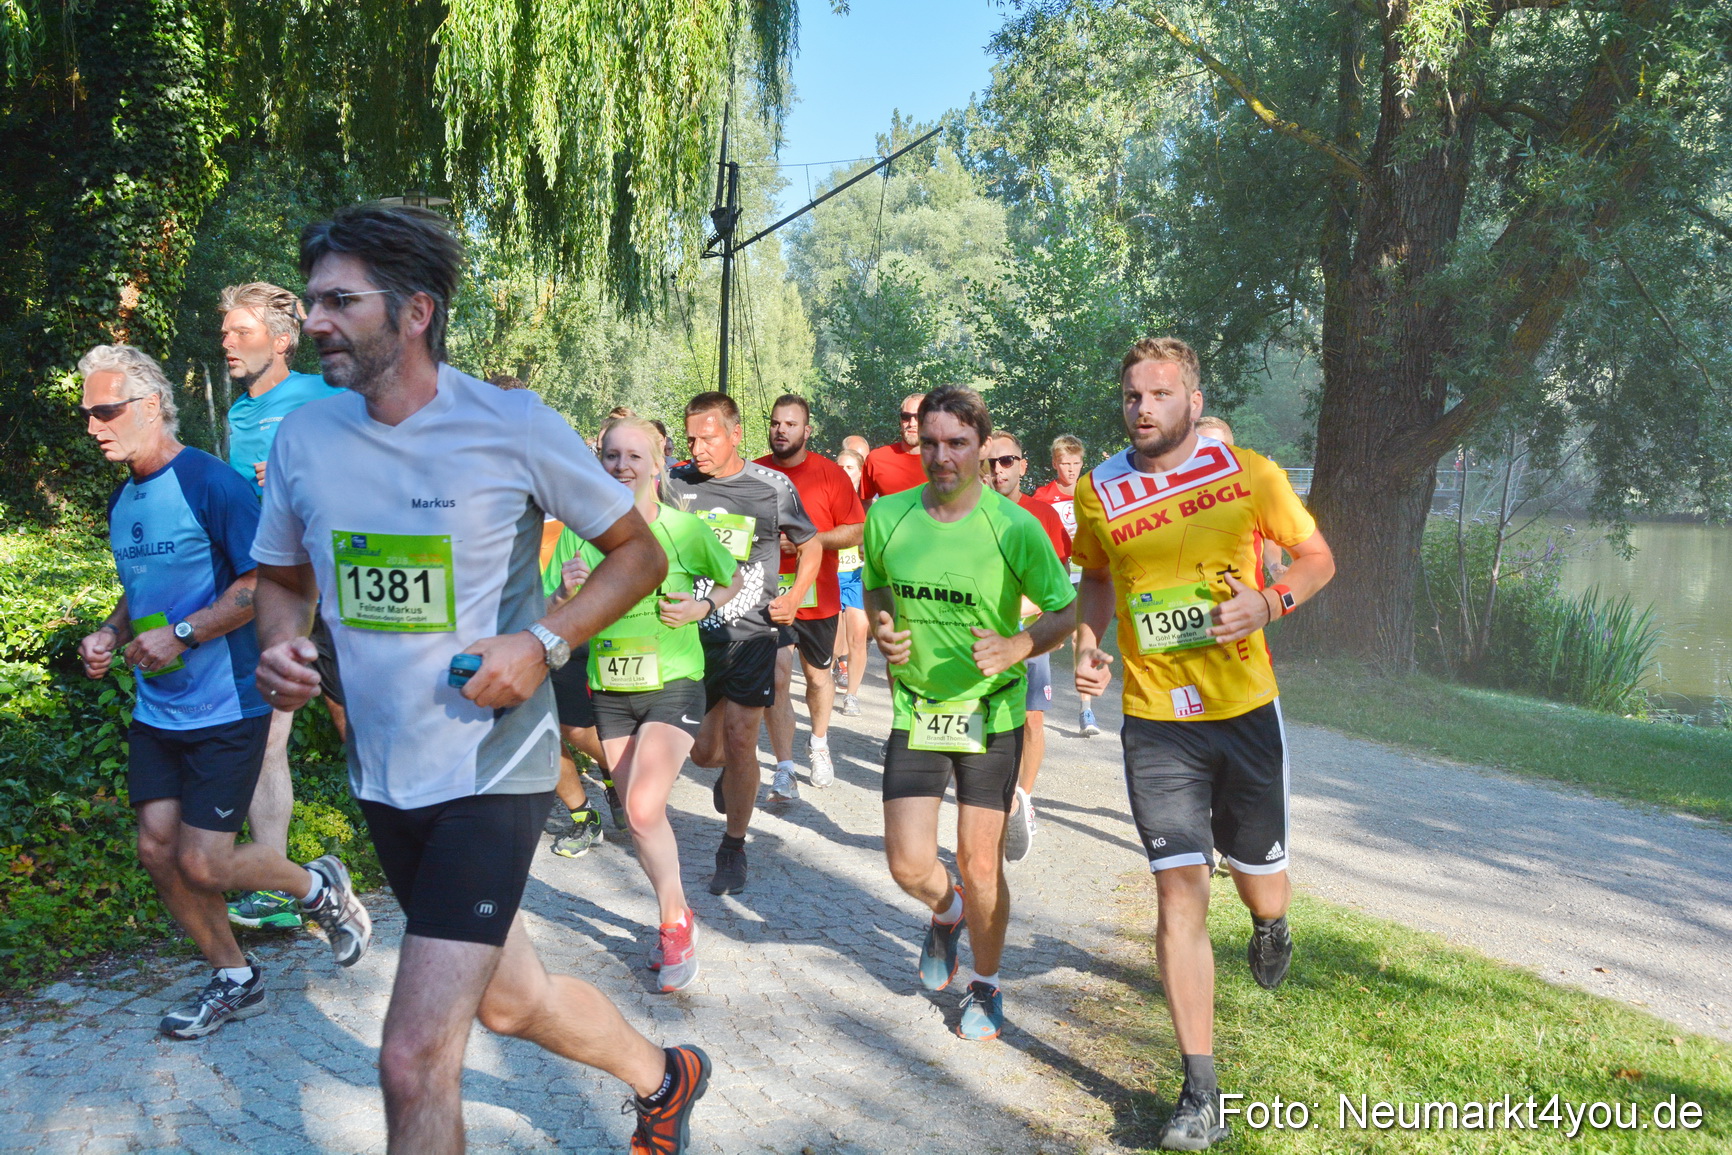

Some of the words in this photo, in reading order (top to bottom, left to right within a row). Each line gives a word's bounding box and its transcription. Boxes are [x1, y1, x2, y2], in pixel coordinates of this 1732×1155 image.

[411, 497, 456, 508] Markus
[1110, 508, 1173, 546] MAX
[1178, 482, 1251, 518] BÖGL
[347, 566, 430, 604] 1381
[892, 582, 977, 607] BRANDL
[387, 604, 423, 614] Markus
[1141, 606, 1204, 635] 1309
[608, 656, 643, 676] 477
[927, 714, 969, 735] 475
[1152, 837, 1167, 849] KG
[1265, 850, 1284, 861] adidas
